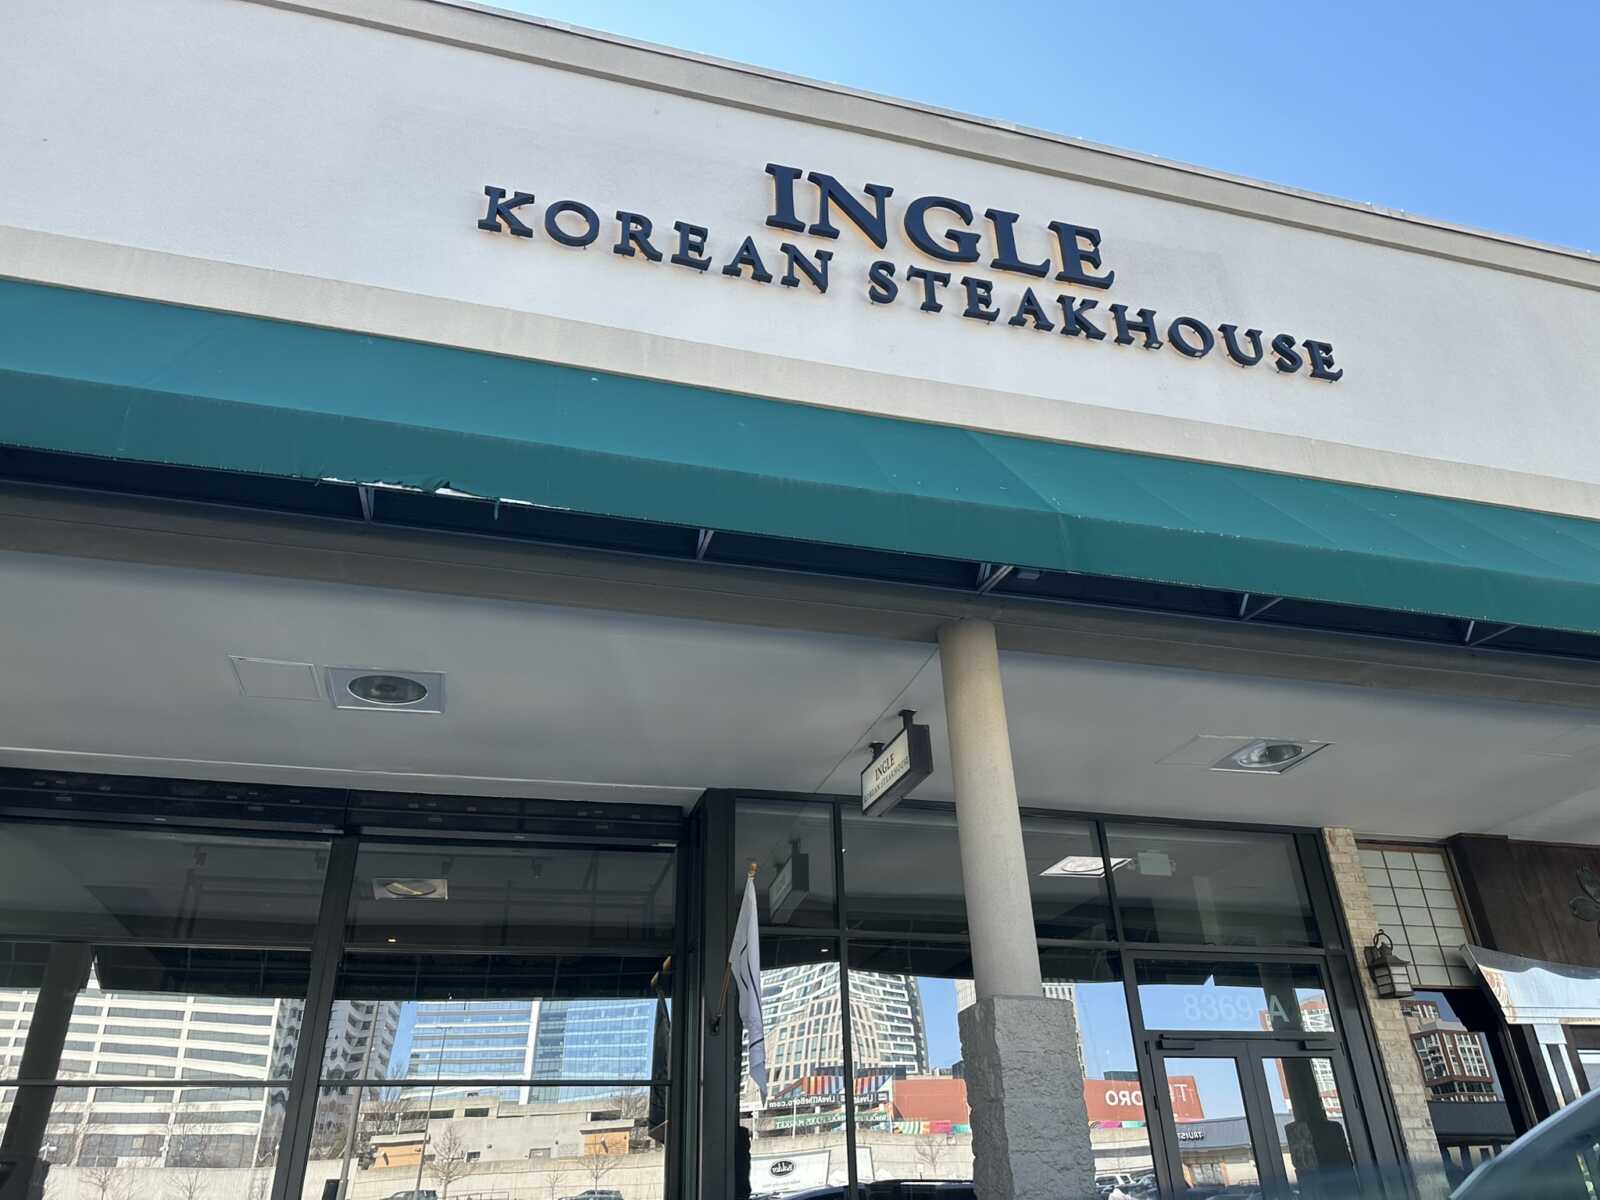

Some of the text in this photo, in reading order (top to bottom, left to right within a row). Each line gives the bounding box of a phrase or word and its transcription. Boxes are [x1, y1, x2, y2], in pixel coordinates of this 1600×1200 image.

[765, 163, 1114, 289] INGLE
[477, 185, 1343, 382] KOREAN STEAKHOUSE
[874, 752, 896, 781] INGLE
[1183, 993, 1290, 1023] 8369 A
